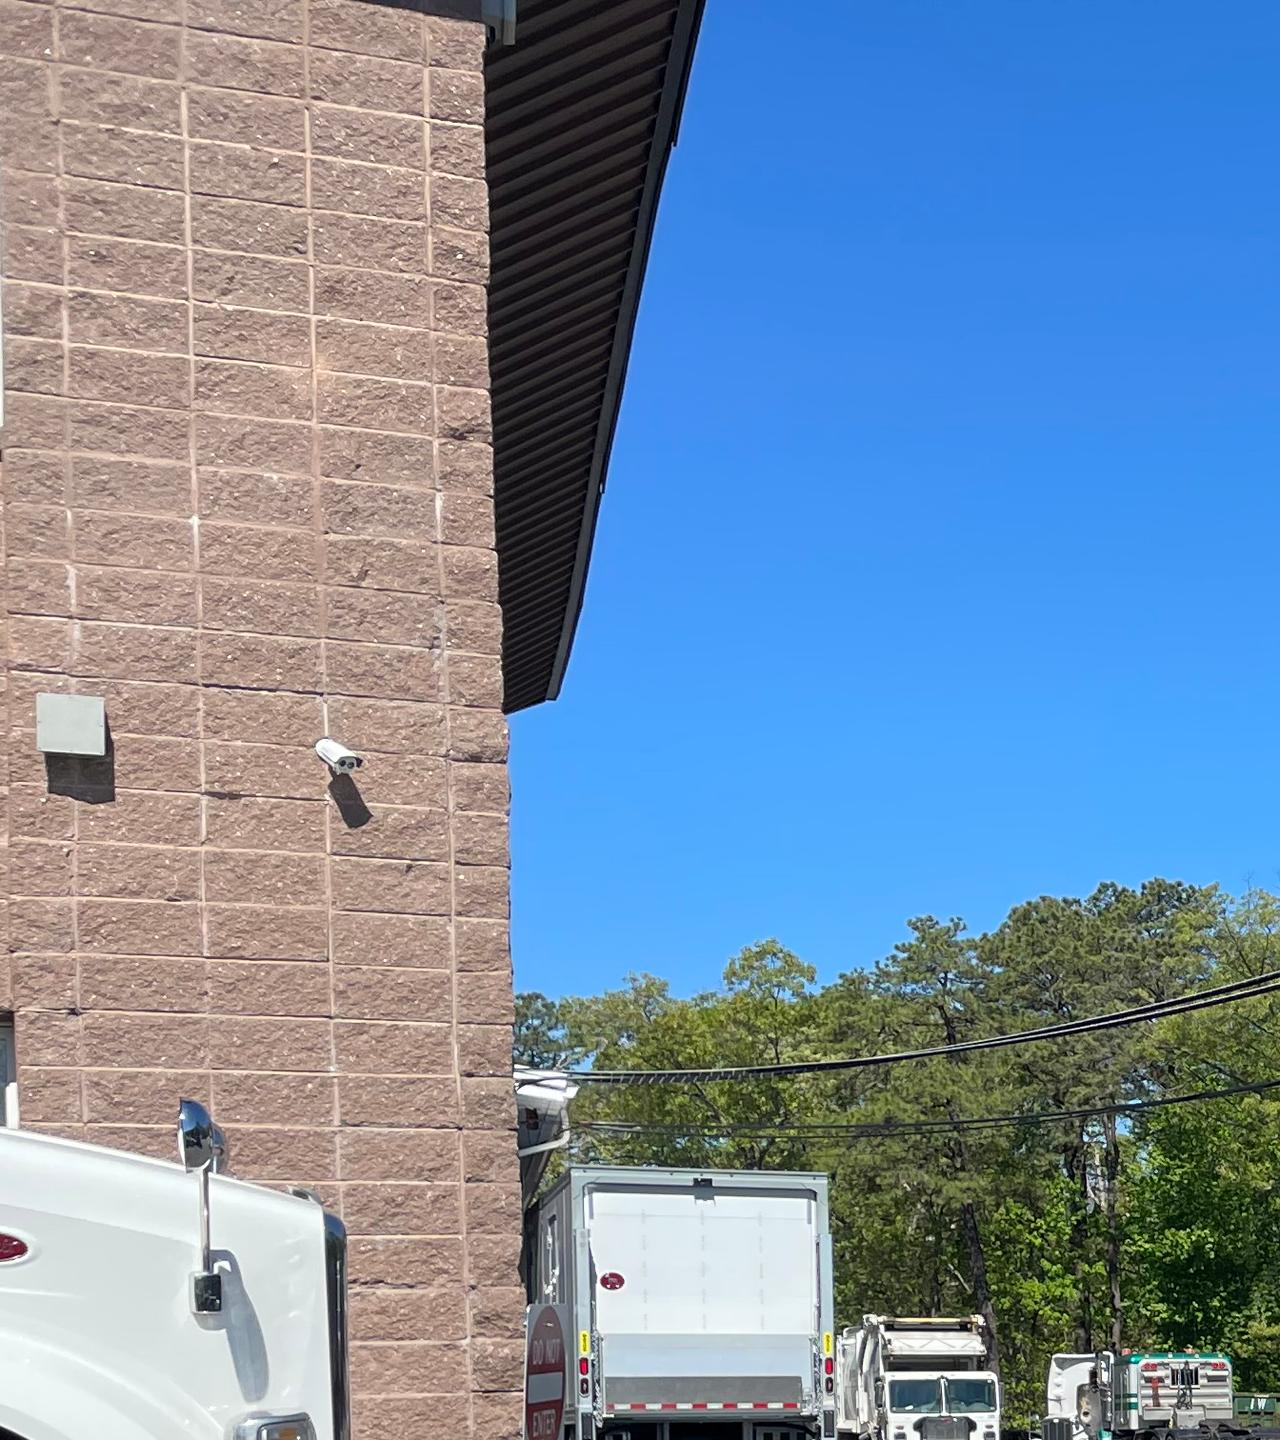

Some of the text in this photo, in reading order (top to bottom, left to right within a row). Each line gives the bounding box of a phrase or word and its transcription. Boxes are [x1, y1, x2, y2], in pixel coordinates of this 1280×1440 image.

[532, 1338, 544, 1366] DO
[545, 1337, 562, 1365] NOT
[532, 1409, 556, 1438] ENTER
